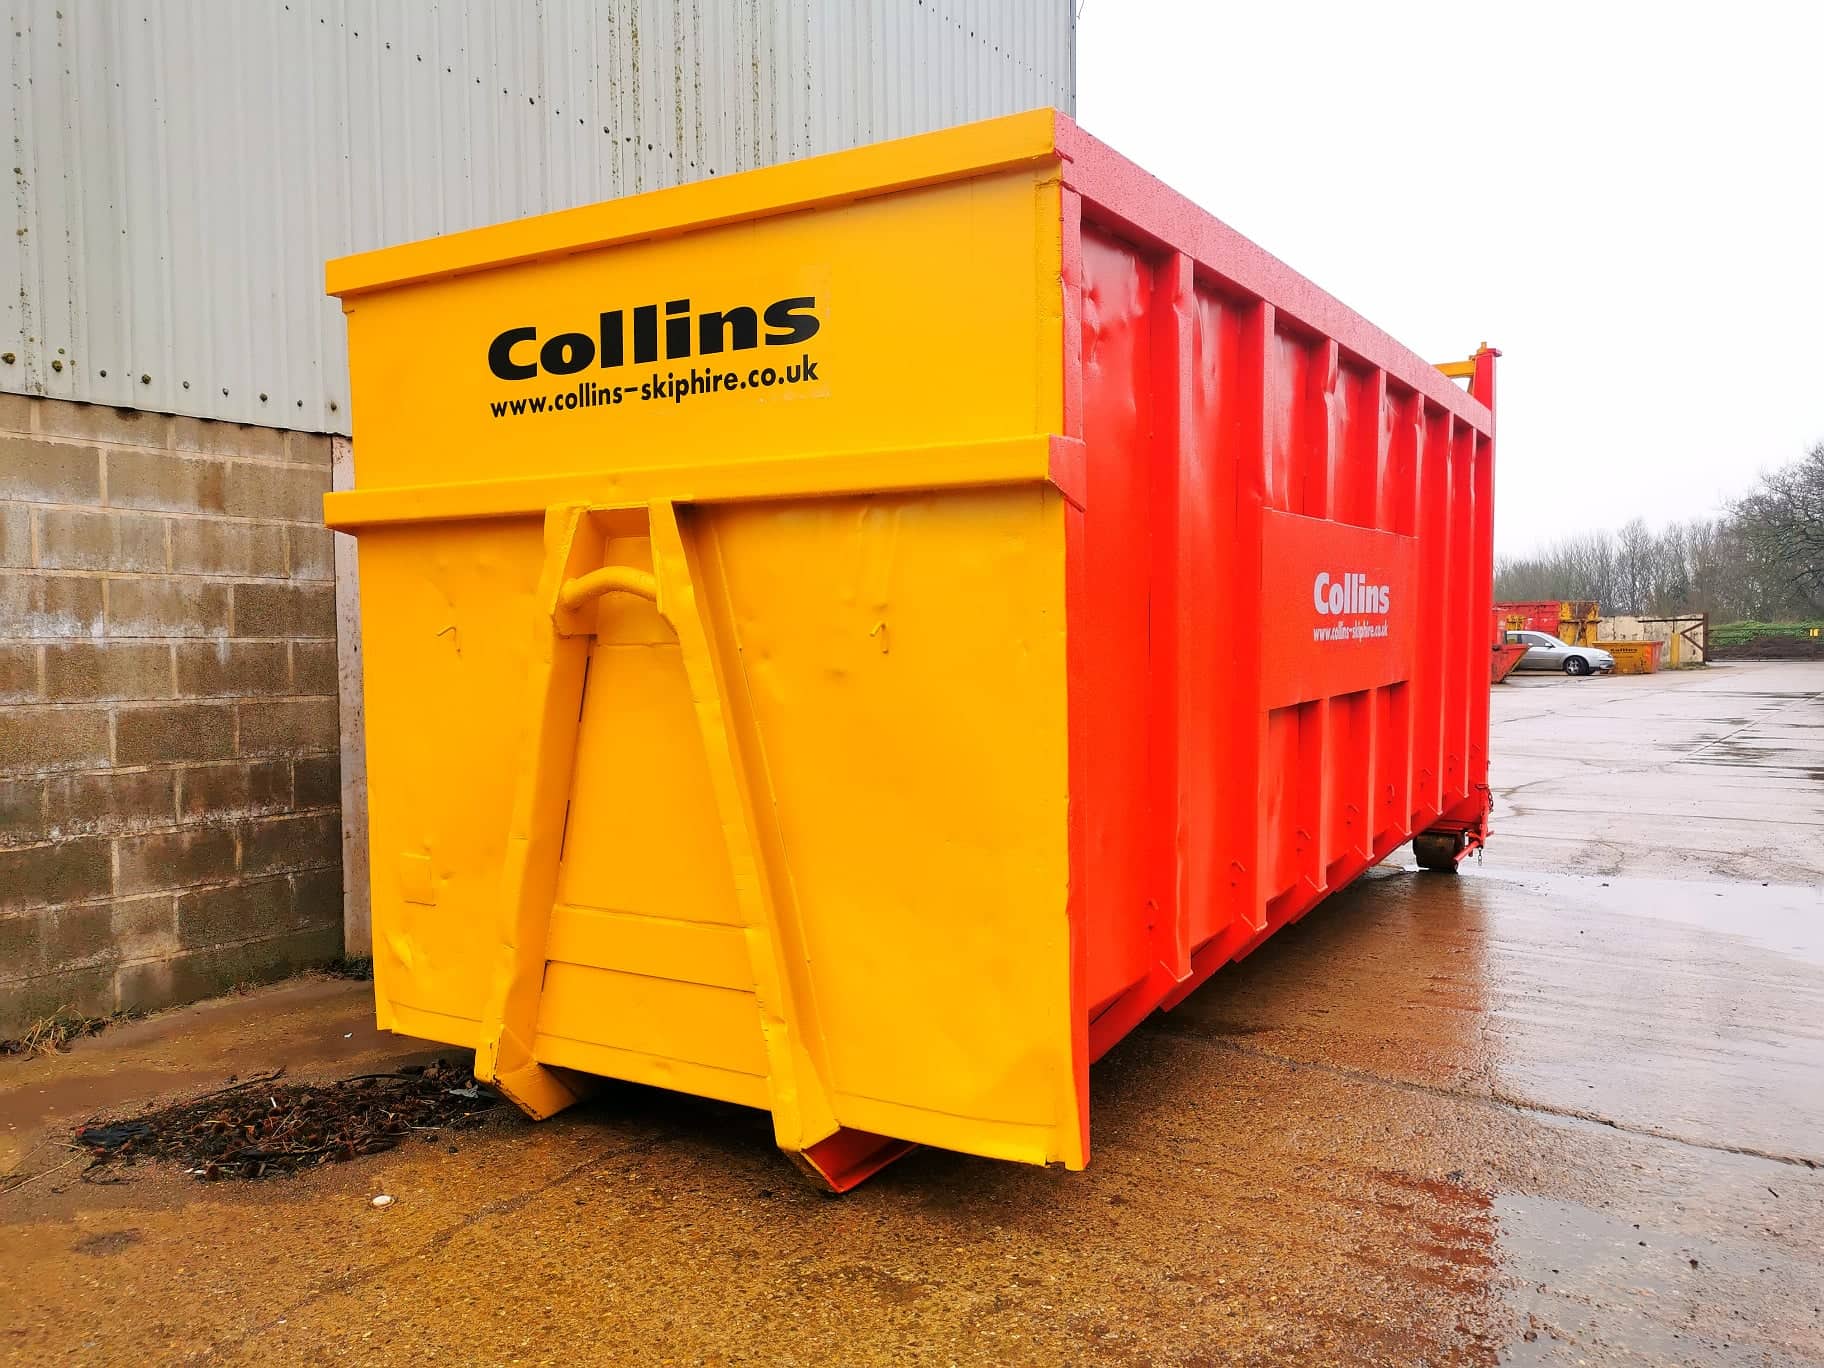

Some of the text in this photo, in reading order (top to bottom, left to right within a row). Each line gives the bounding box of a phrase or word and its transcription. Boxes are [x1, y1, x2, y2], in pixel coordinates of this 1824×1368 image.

[488, 296, 820, 381] Collins
[490, 354, 818, 418] www.collins-skiphire.co.uk
[1313, 572, 1390, 615] Collins
